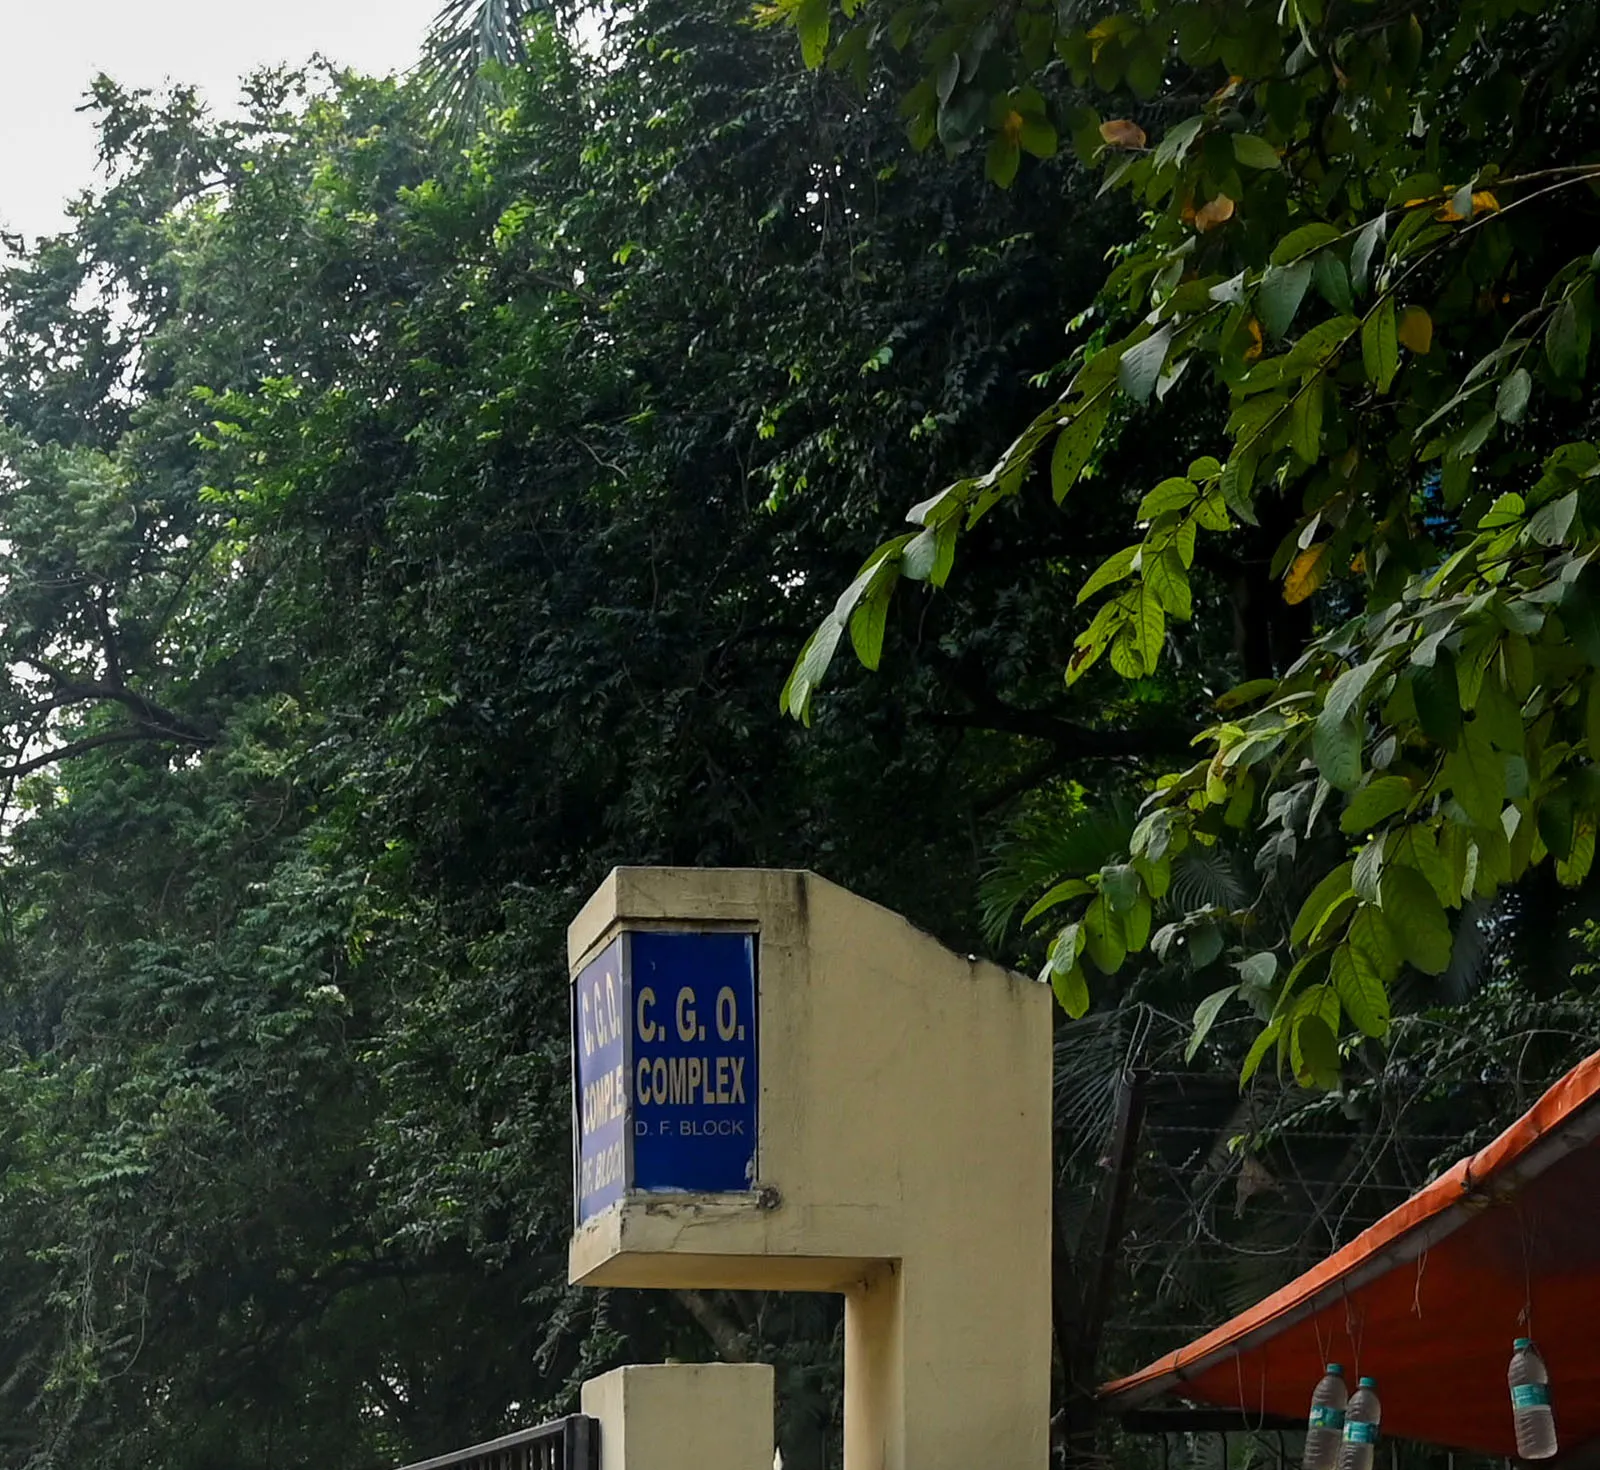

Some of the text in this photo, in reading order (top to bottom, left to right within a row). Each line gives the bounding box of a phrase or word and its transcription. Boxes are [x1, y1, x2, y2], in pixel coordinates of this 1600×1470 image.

[637, 985, 745, 1042] C. G. O.
[583, 1064, 624, 1137] COMPLE
[636, 1056, 746, 1106] COMPLEX
[635, 1120, 654, 1136] D.
[679, 1119, 745, 1136] BLOCK
